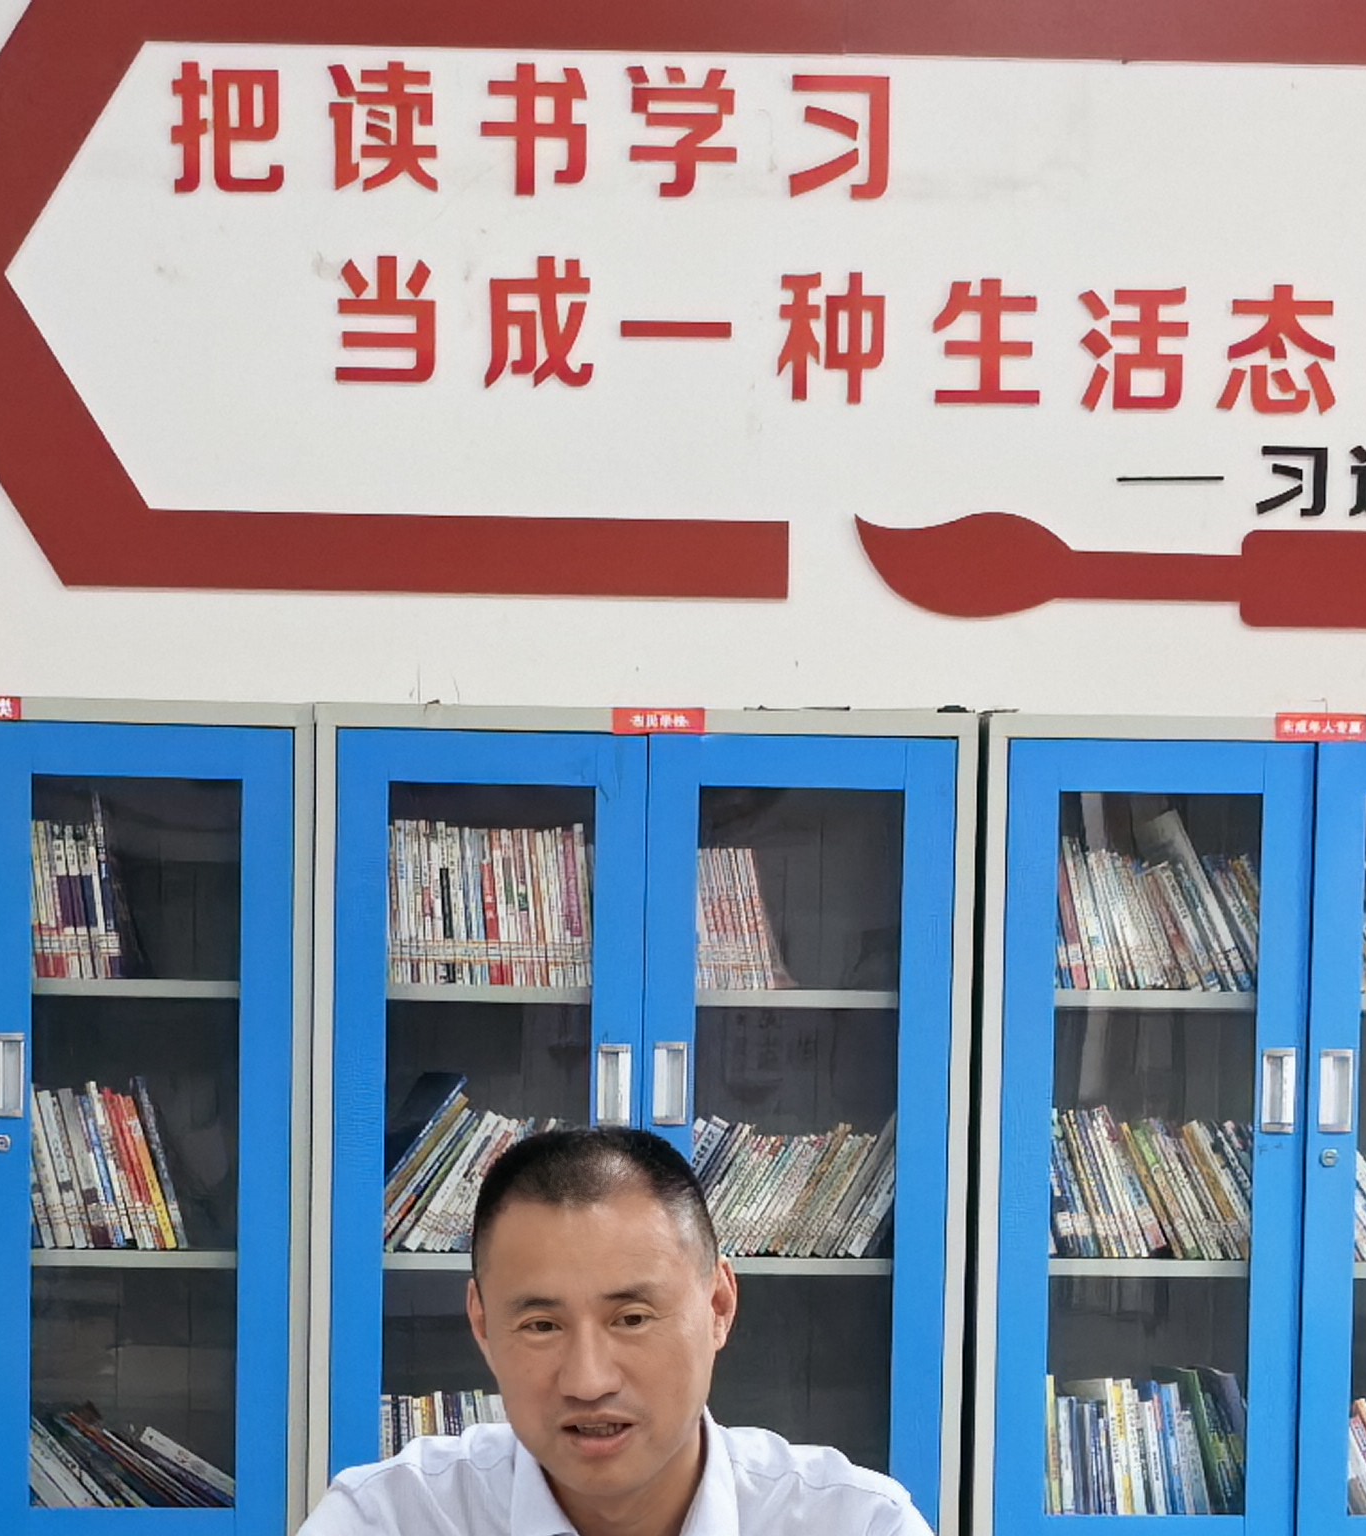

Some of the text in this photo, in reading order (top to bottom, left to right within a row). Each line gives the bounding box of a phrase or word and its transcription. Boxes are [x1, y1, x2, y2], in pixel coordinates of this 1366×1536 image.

[170, 61, 892, 200] 把读书学习
